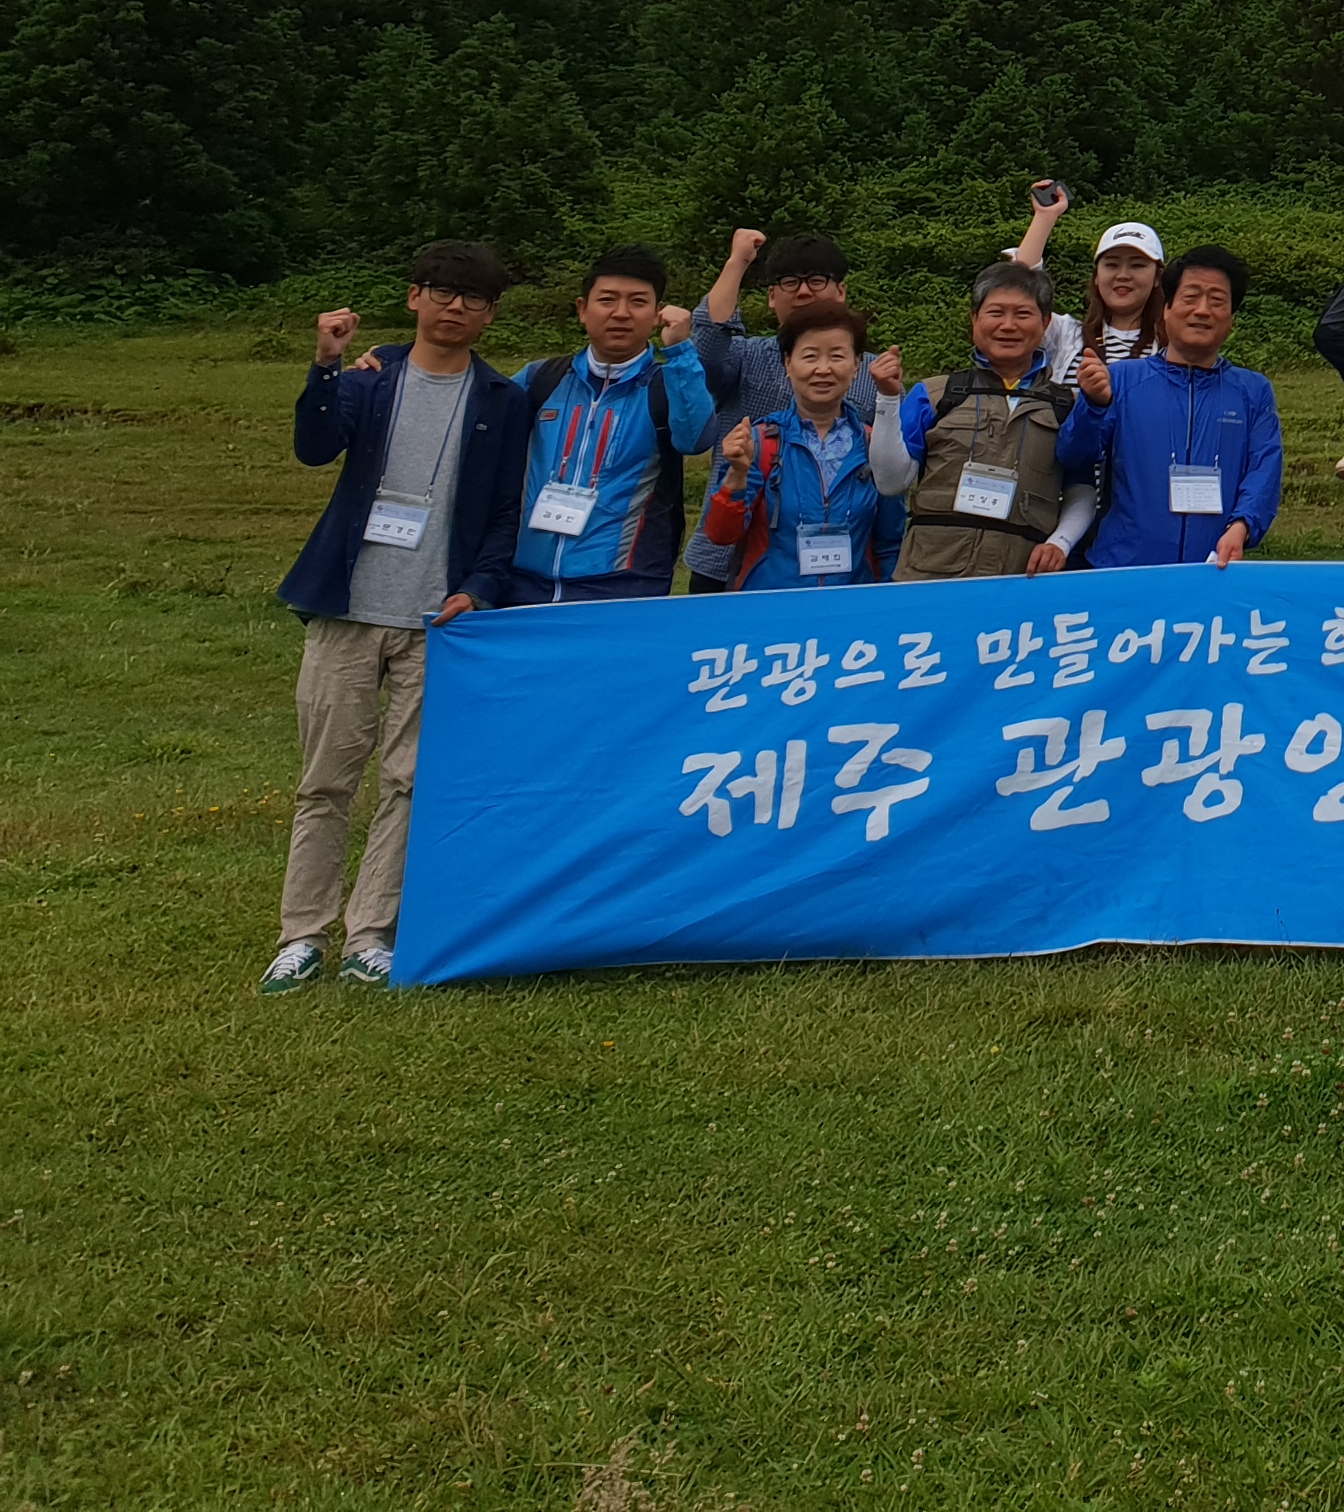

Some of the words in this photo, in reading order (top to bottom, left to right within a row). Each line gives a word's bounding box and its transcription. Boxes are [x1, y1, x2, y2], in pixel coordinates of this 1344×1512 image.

[688, 632, 948, 713] 관광으로
[977, 610, 1289, 690] 만들어가는
[679, 723, 933, 842] 제주
